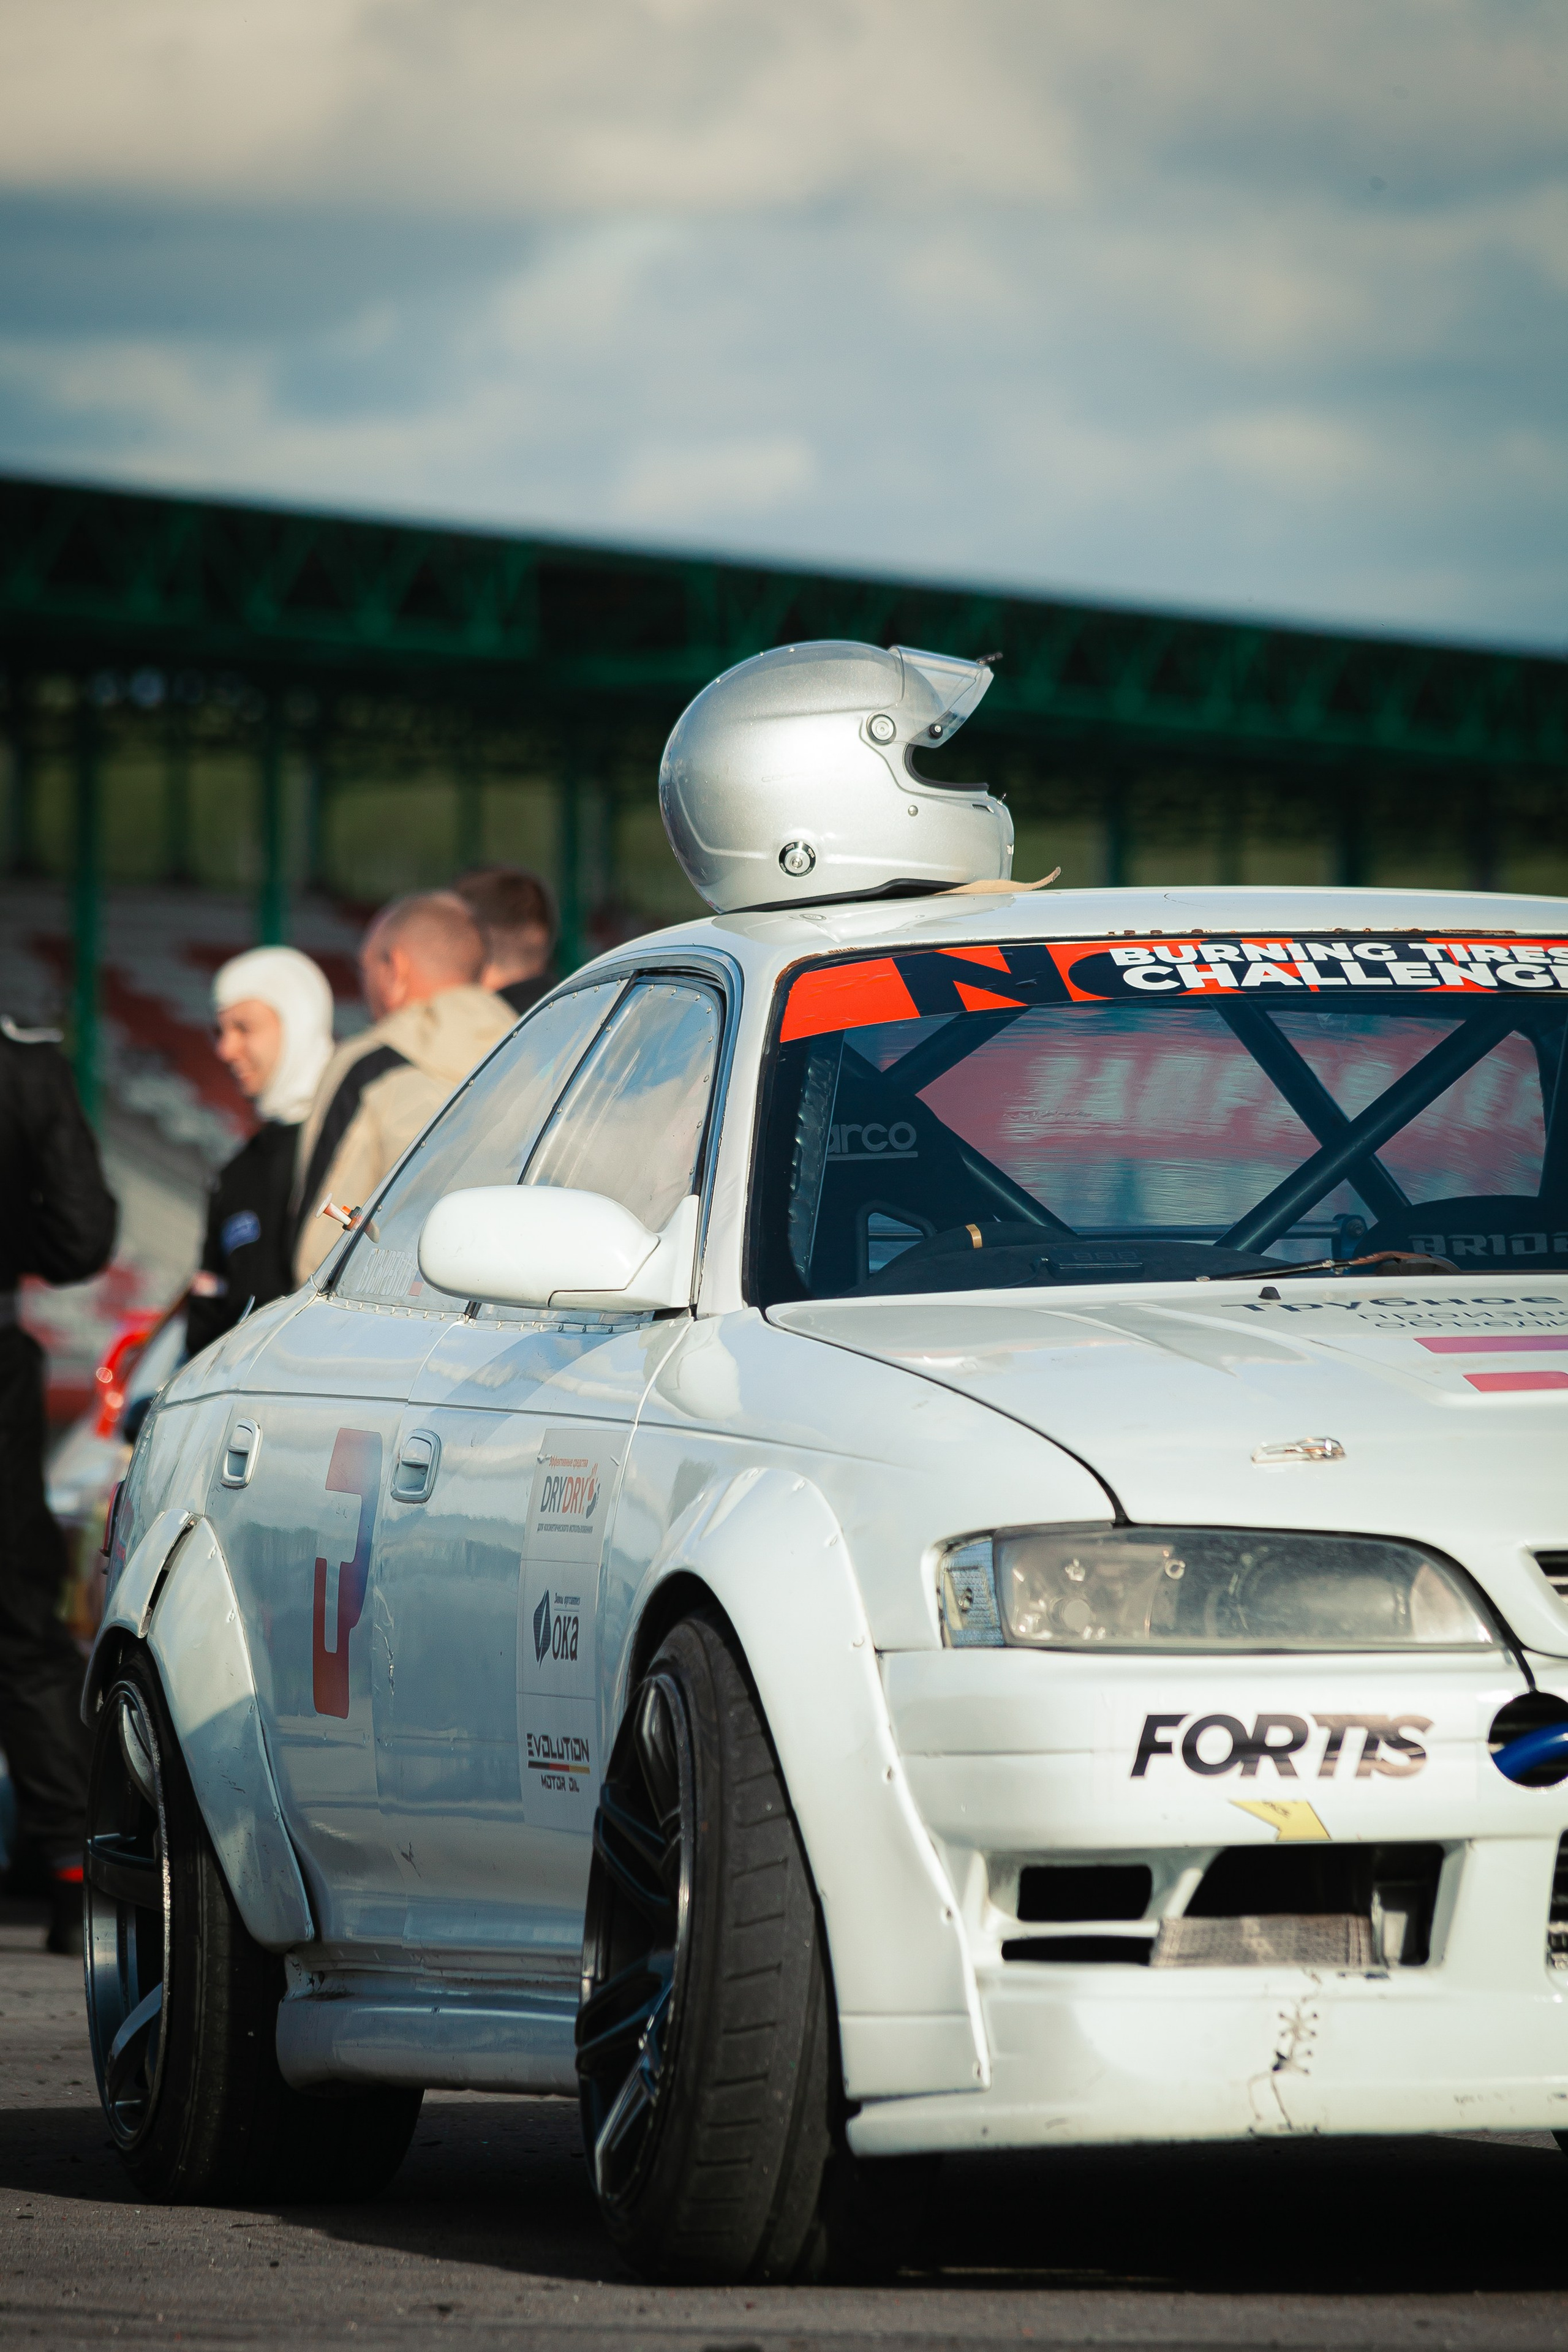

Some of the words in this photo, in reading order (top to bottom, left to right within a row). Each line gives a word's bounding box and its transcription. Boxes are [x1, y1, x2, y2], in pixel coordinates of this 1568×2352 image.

[1109, 942, 1398, 966] BURNING
[1407, 943, 1568, 964] TIRES
[1221, 1296, 1564, 1313] Трубное
[527, 1733, 590, 1763] EVOLUTION
[1131, 1714, 1434, 1777] FORTIS
[541, 1774, 566, 1792] MOTOR
[568, 1777, 579, 1793] OIL
